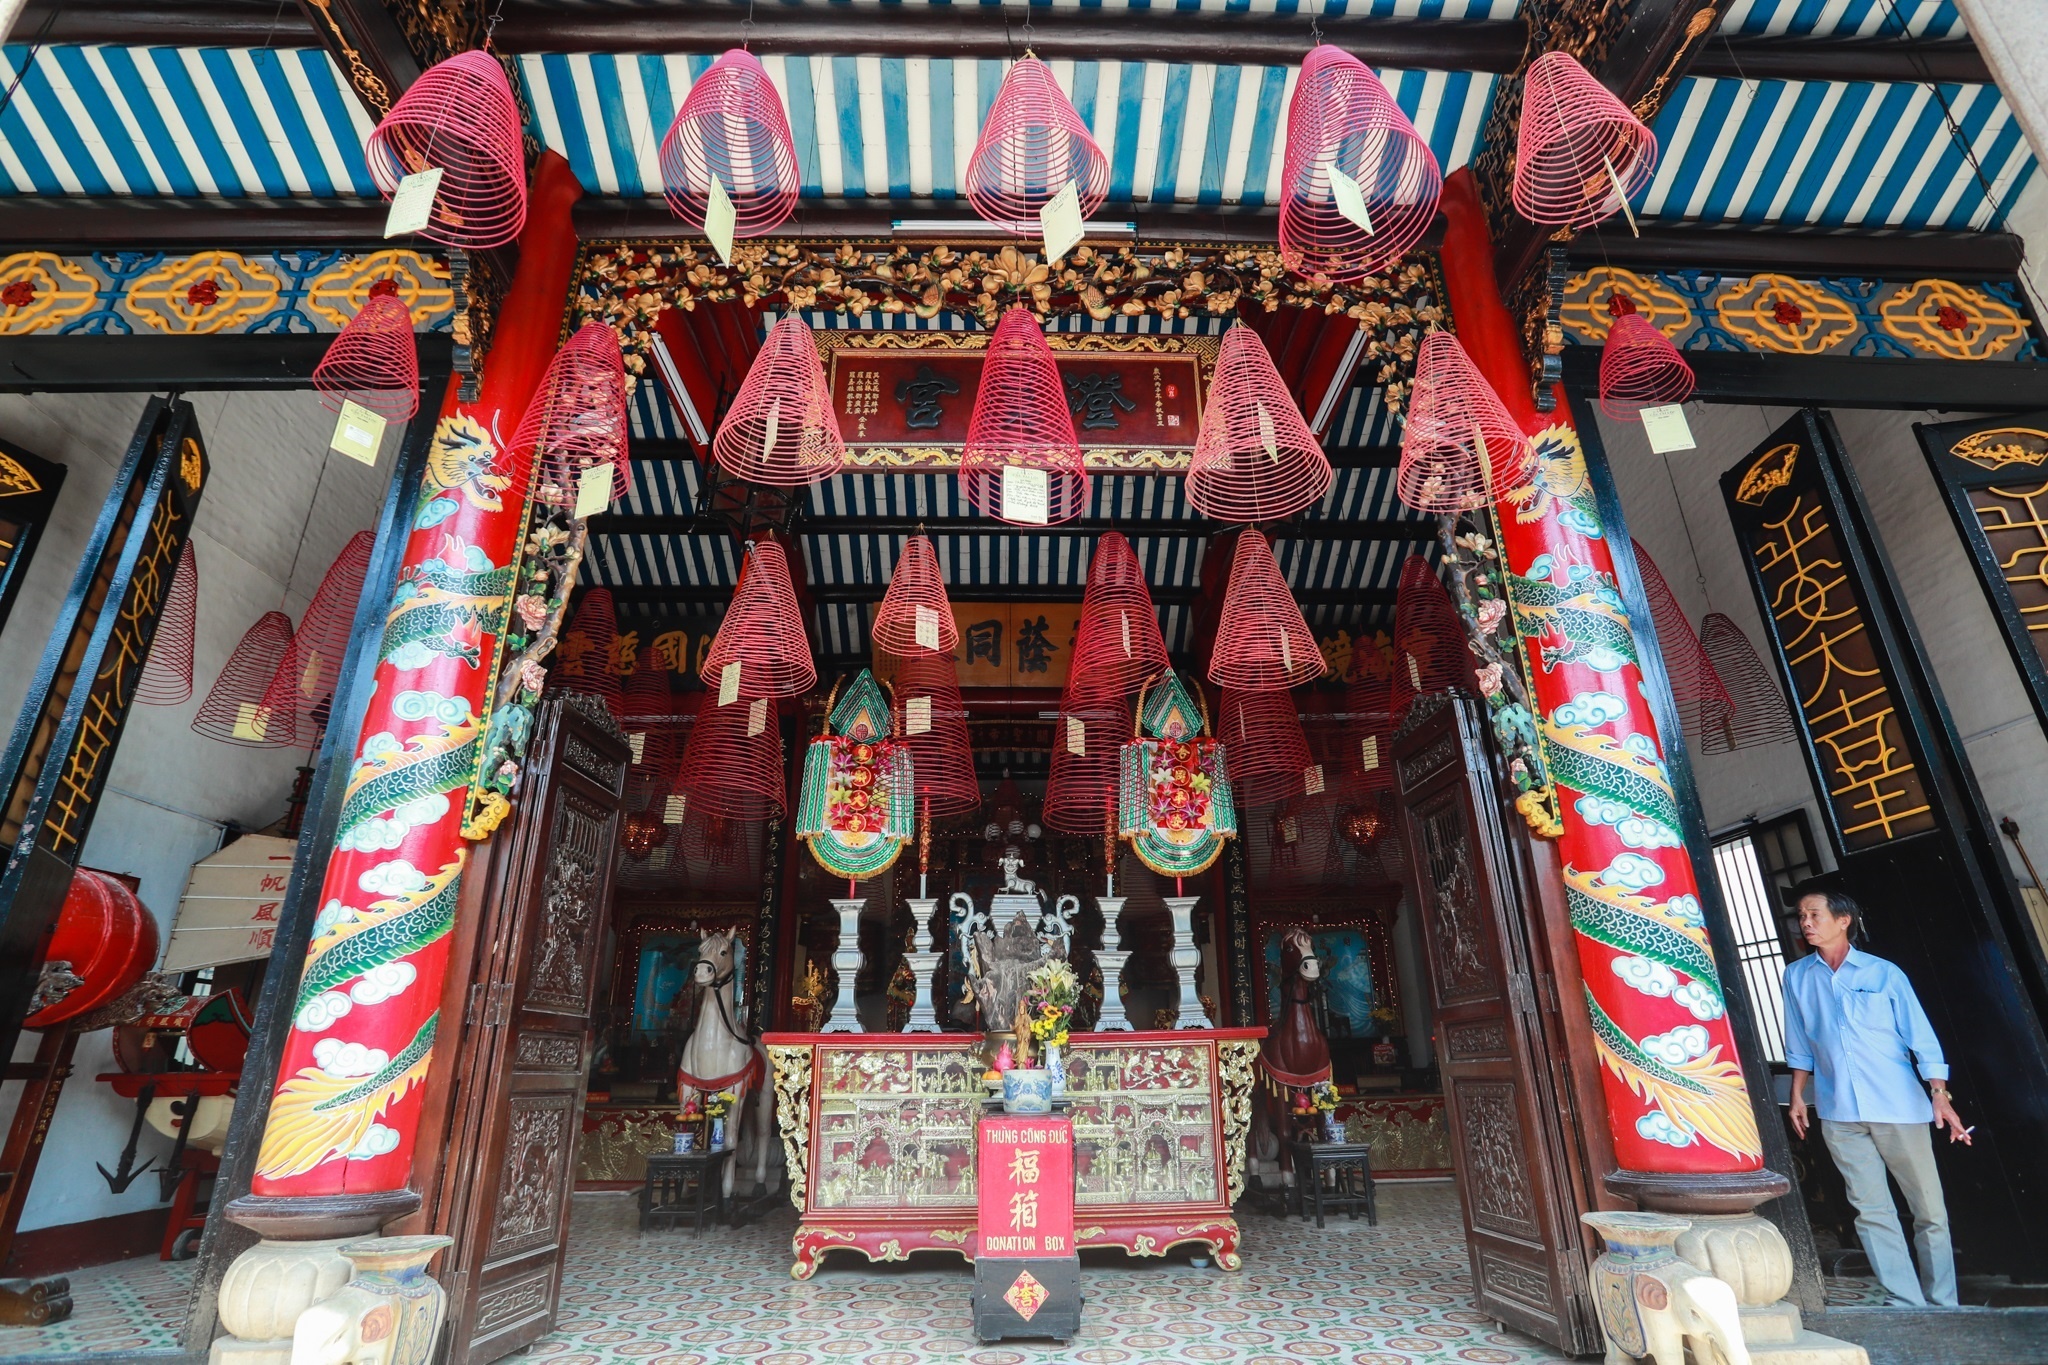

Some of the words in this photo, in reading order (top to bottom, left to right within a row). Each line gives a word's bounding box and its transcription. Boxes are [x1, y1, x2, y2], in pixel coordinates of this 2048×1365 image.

[249, 856, 292, 949] 一帆風順
[986, 1125, 1018, 1144] THÙNG
[1020, 1127, 1047, 1144] CÔNG
[1048, 1124, 1068, 1144] ĐỨC
[1008, 1148, 1040, 1232] 福箱
[986, 1235, 1036, 1251] DONATION
[1045, 1235, 1065, 1251] BOX
